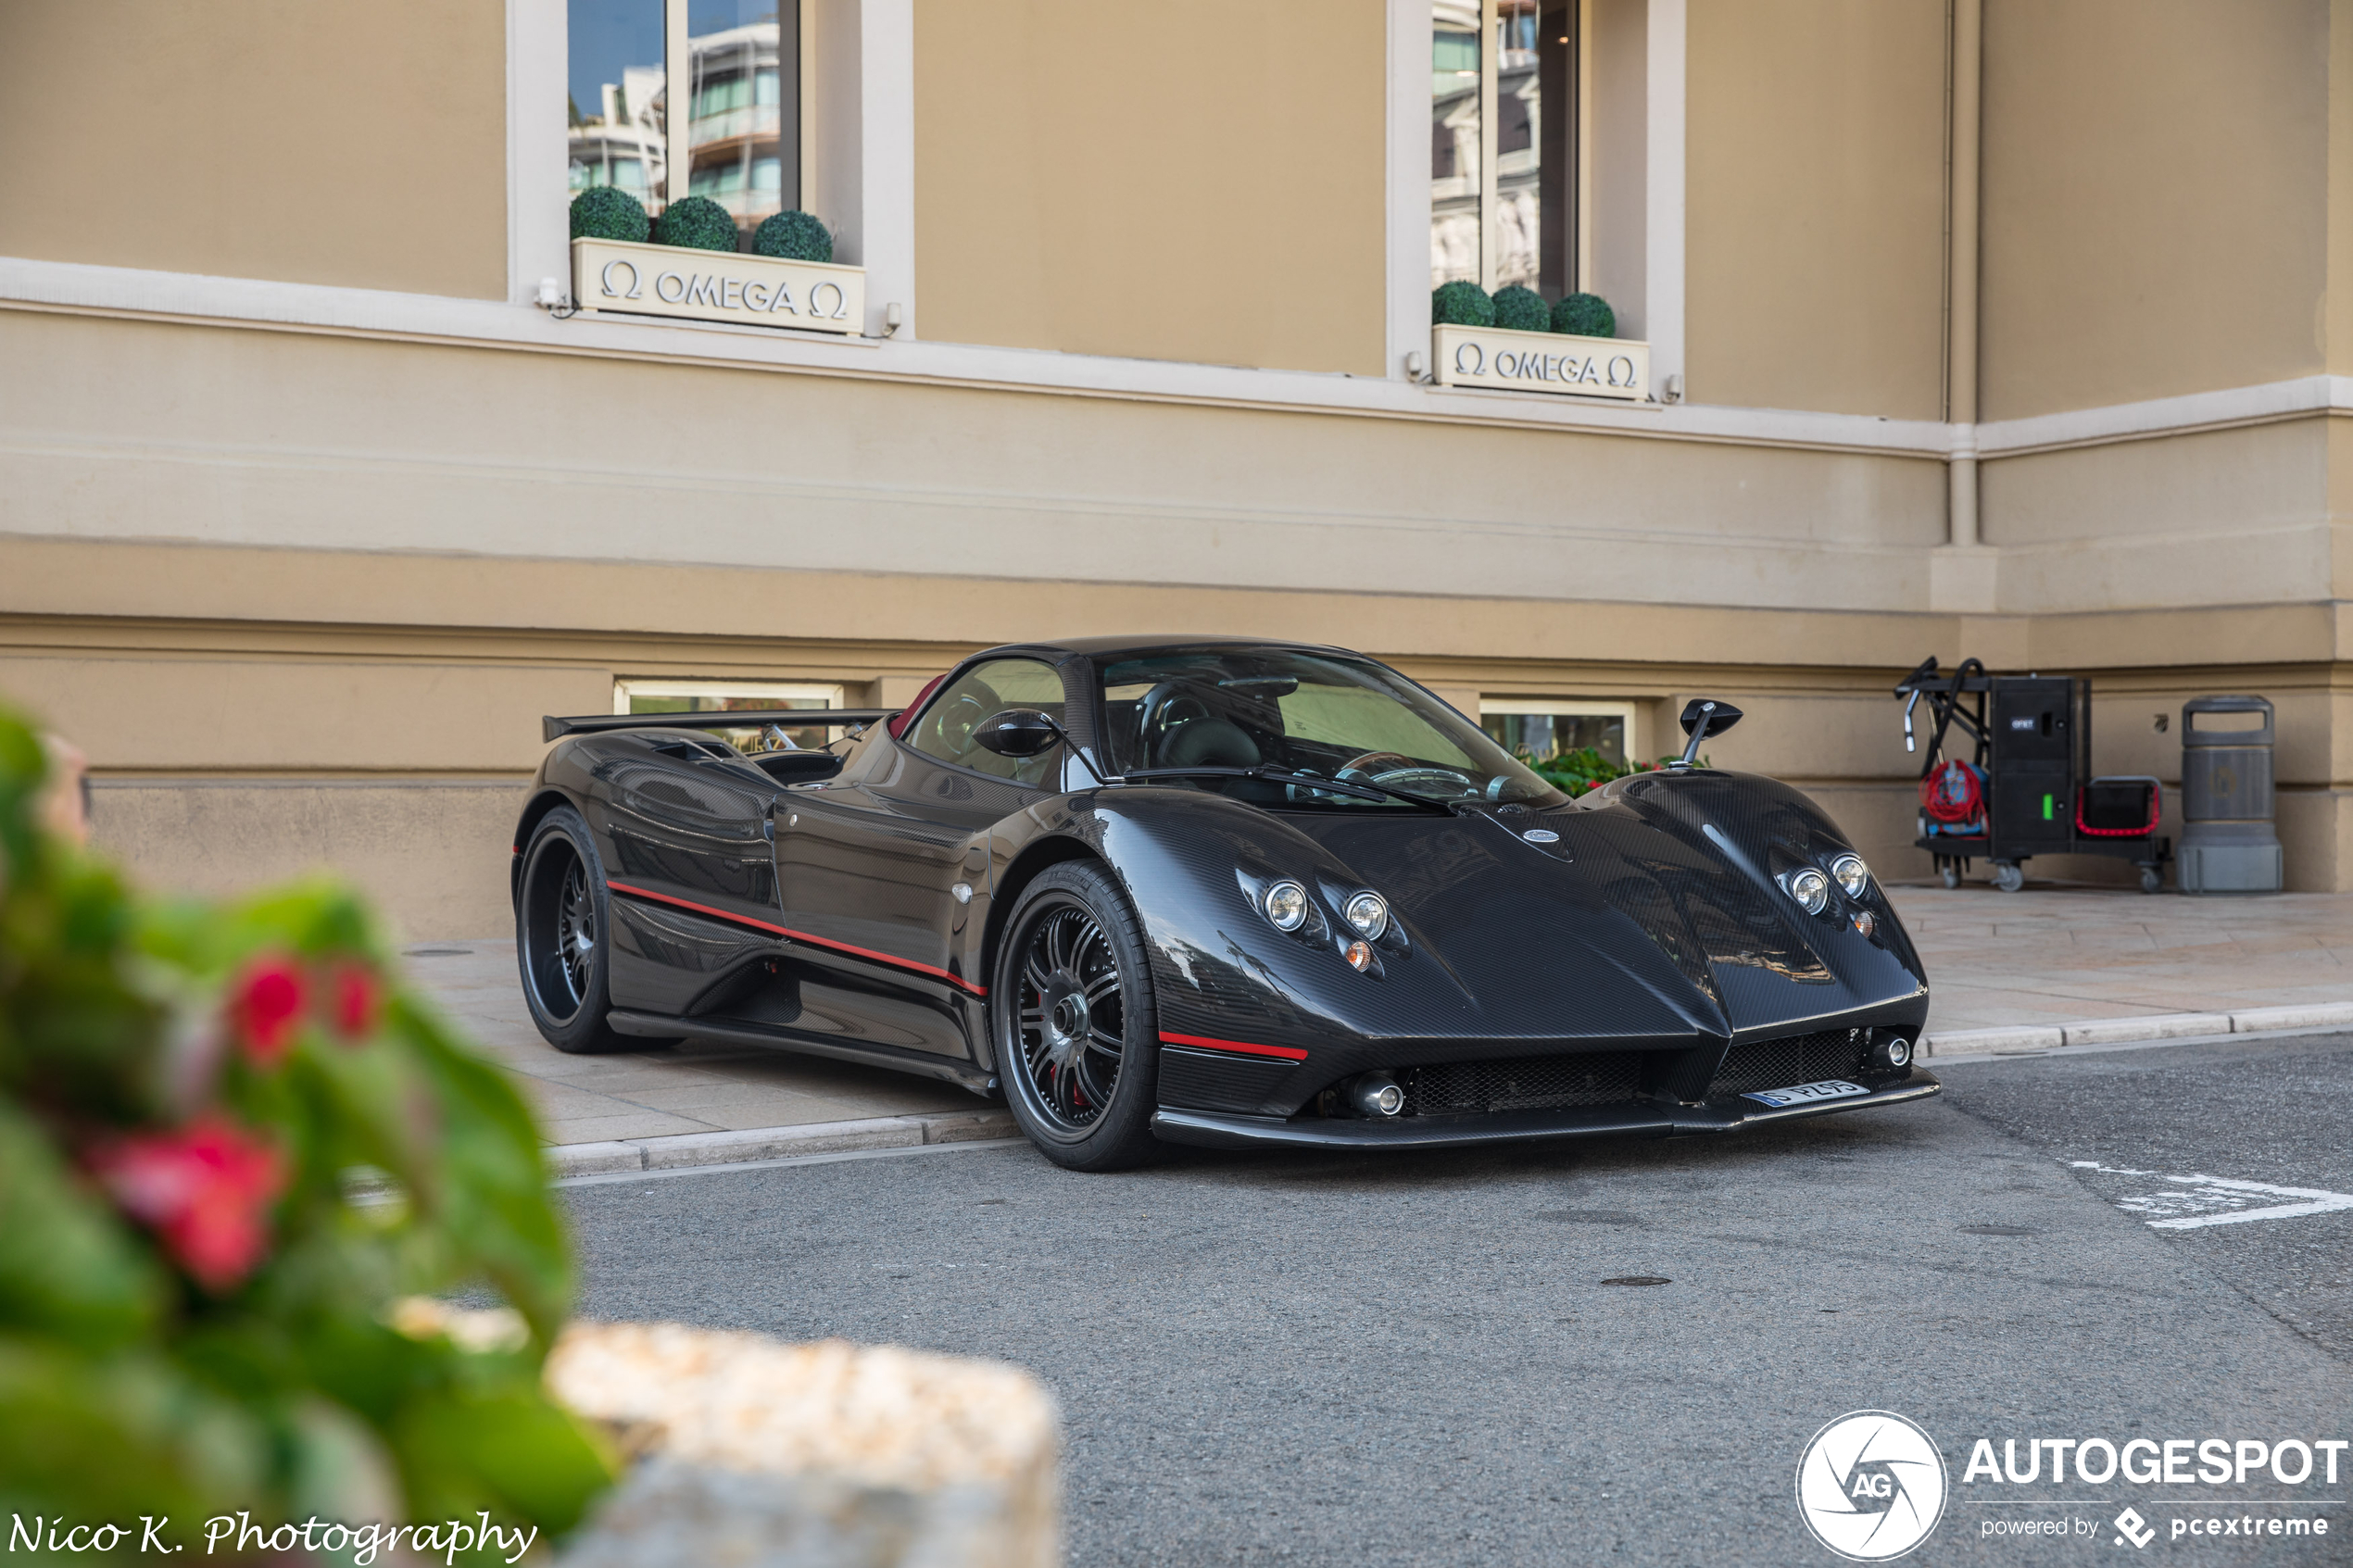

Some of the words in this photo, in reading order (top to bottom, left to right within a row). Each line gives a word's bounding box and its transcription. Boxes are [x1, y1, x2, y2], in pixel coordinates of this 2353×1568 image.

[656, 271, 799, 315] OMEGA
[1495, 349, 1602, 385] OMEGA
[1763, 1092, 1792, 1102] S
